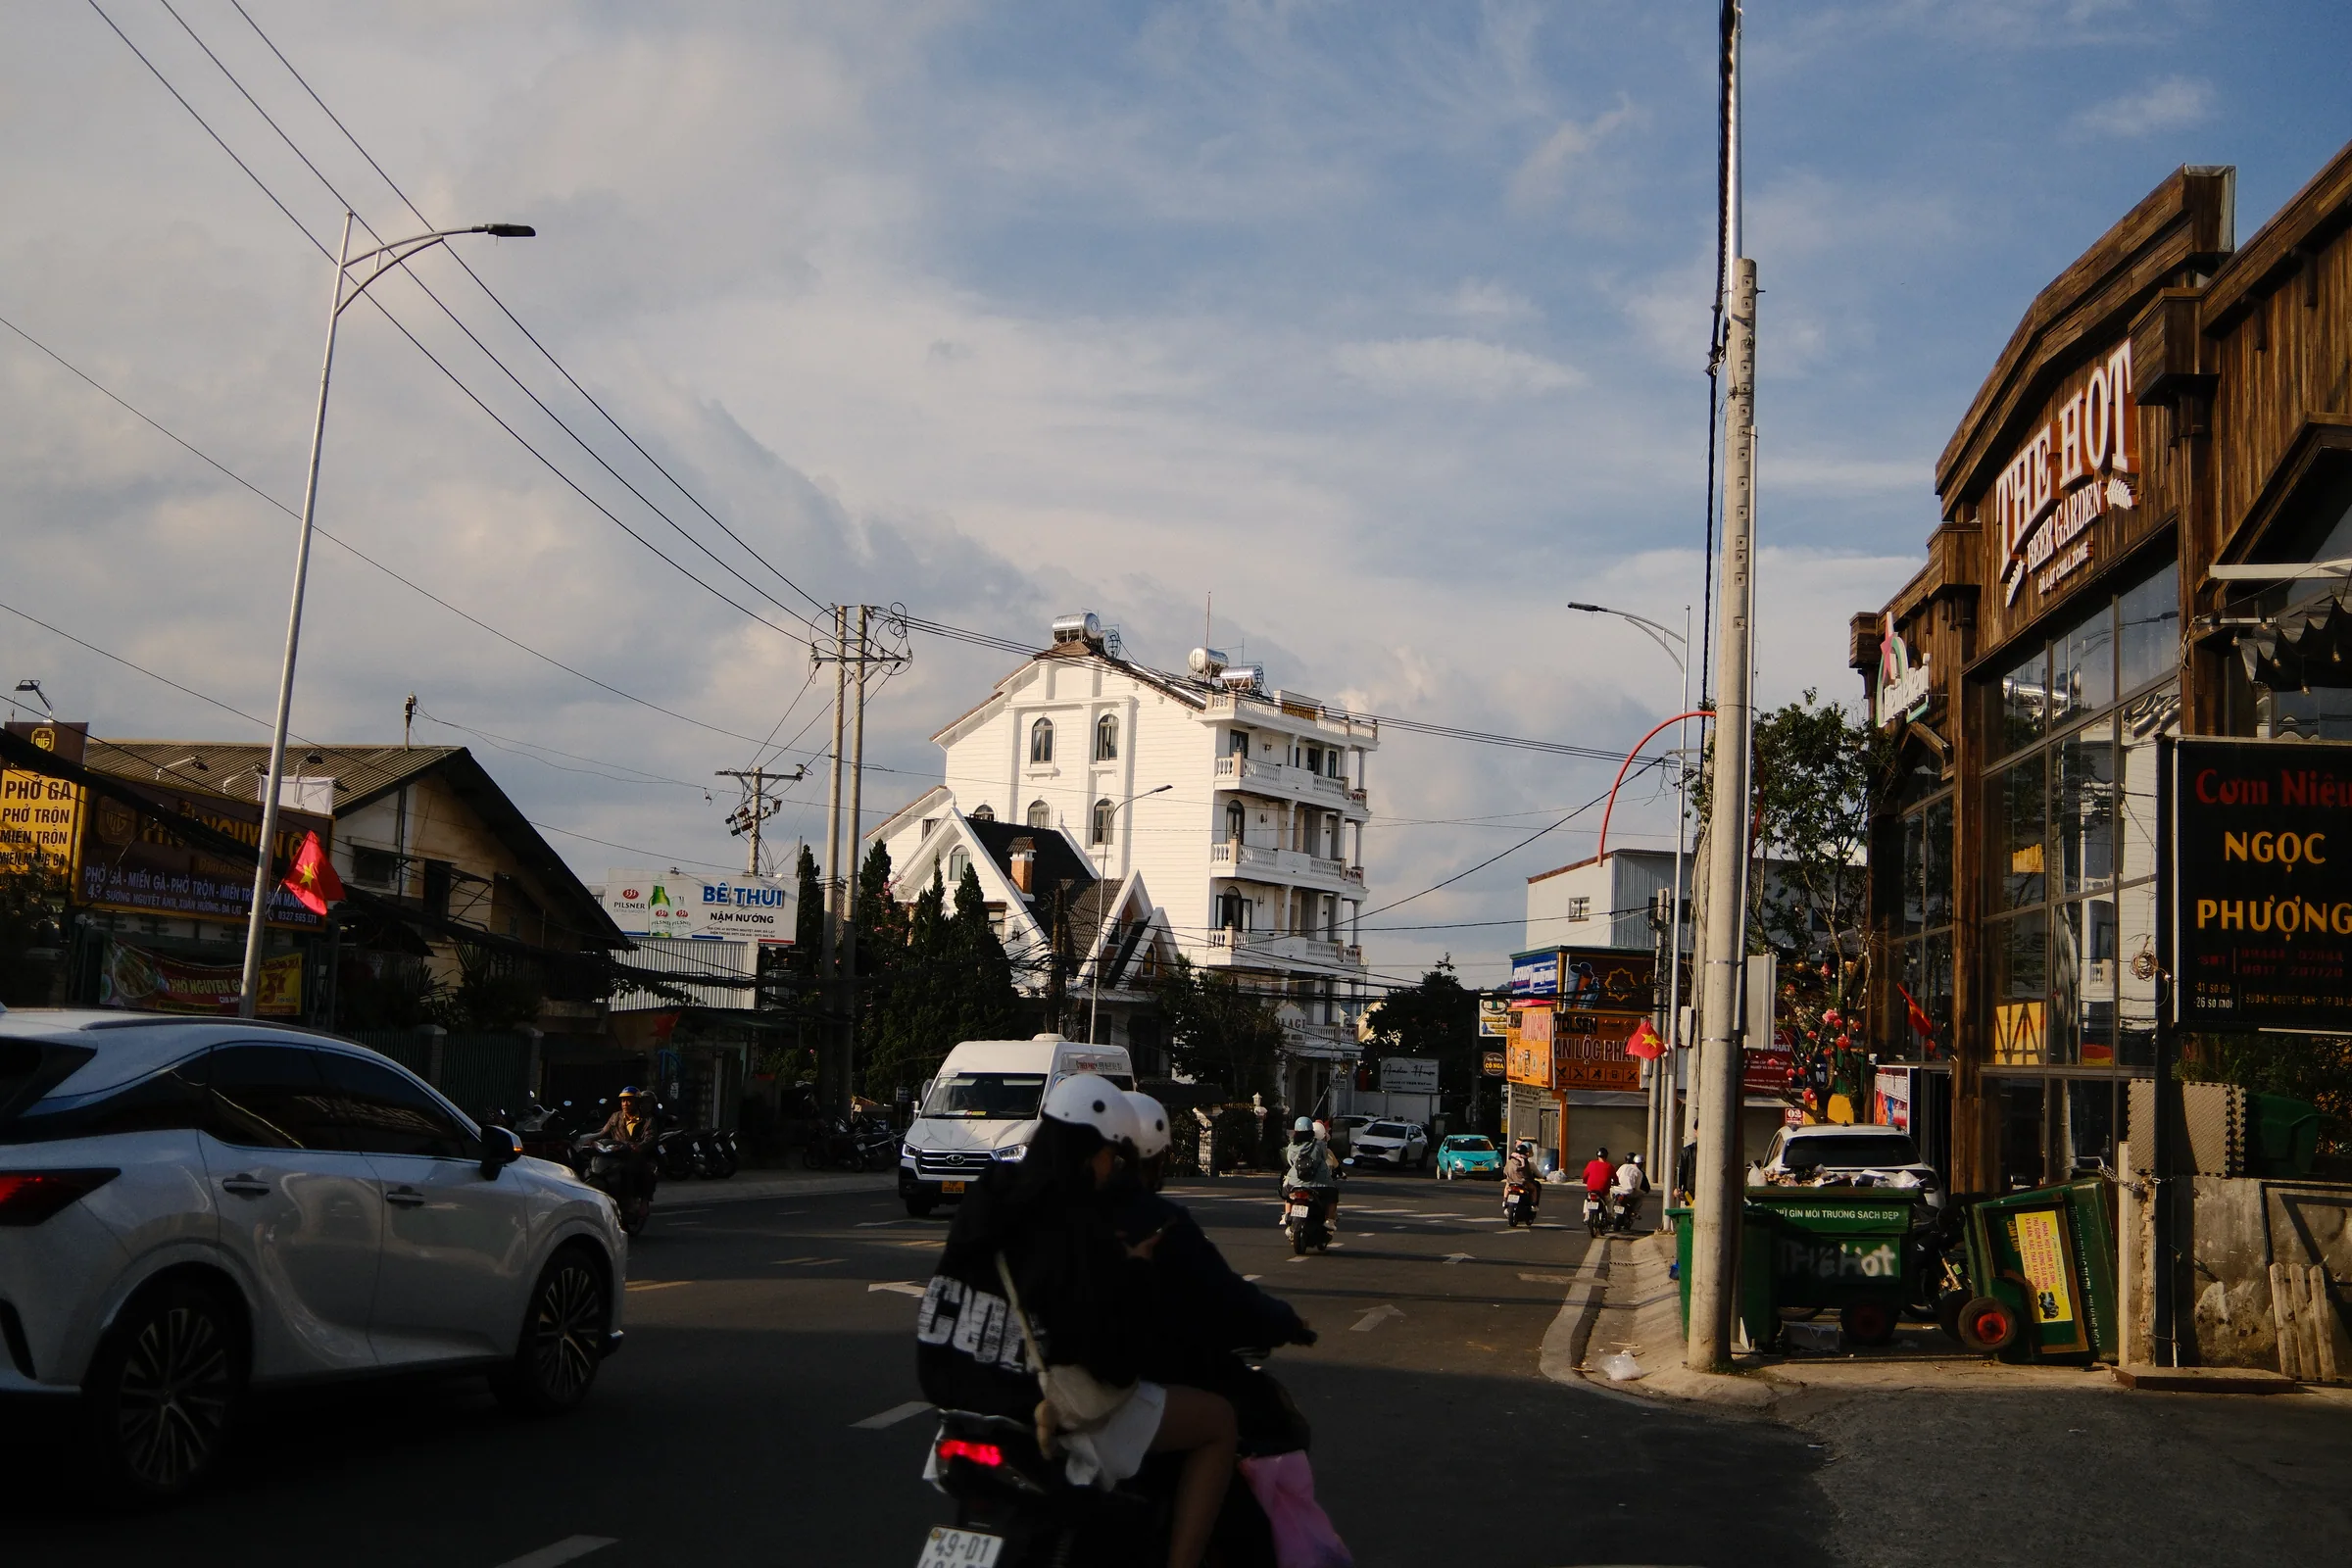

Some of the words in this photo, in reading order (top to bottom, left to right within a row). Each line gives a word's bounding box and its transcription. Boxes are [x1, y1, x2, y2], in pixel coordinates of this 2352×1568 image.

[1995, 421, 2055, 583] THE
[2059, 337, 2133, 490] HOT
[2027, 515, 2054, 573] BEER
[2055, 480, 2102, 549] GARDEN
[2056, 558, 2072, 580] CHILL
[2072, 541, 2088, 565] ZONE
[5, 774, 42, 800] PHỞ
[2195, 767, 2270, 806] Cơm
[2, 804, 30, 823] PHỞ
[34, 807, 70, 826] TRỘN
[36, 829, 68, 847] TRỘN
[2224, 831, 2327, 873] NGỌC
[85, 862, 106, 882] PHỞ
[127, 868, 150, 889] MIẾN
[153, 872, 166, 891] GÀ
[171, 874, 190, 894] PHỞ
[192, 878, 216, 900] TRỘN
[220, 883, 239, 901] MIẾN
[703, 882, 730, 905] BÊ
[733, 888, 784, 906] THUI
[736, 911, 774, 924] NƯỚNG
[2196, 894, 2352, 942] PHƯỢNG
[1554, 1015, 1597, 1034] TOLSEN
[1555, 1037, 1572, 1058] AN
[1574, 1034, 1602, 1064] LỘC
[1603, 1036, 1637, 1062] PHÁ
[1882, 1211, 1899, 1222] ĐẸP
